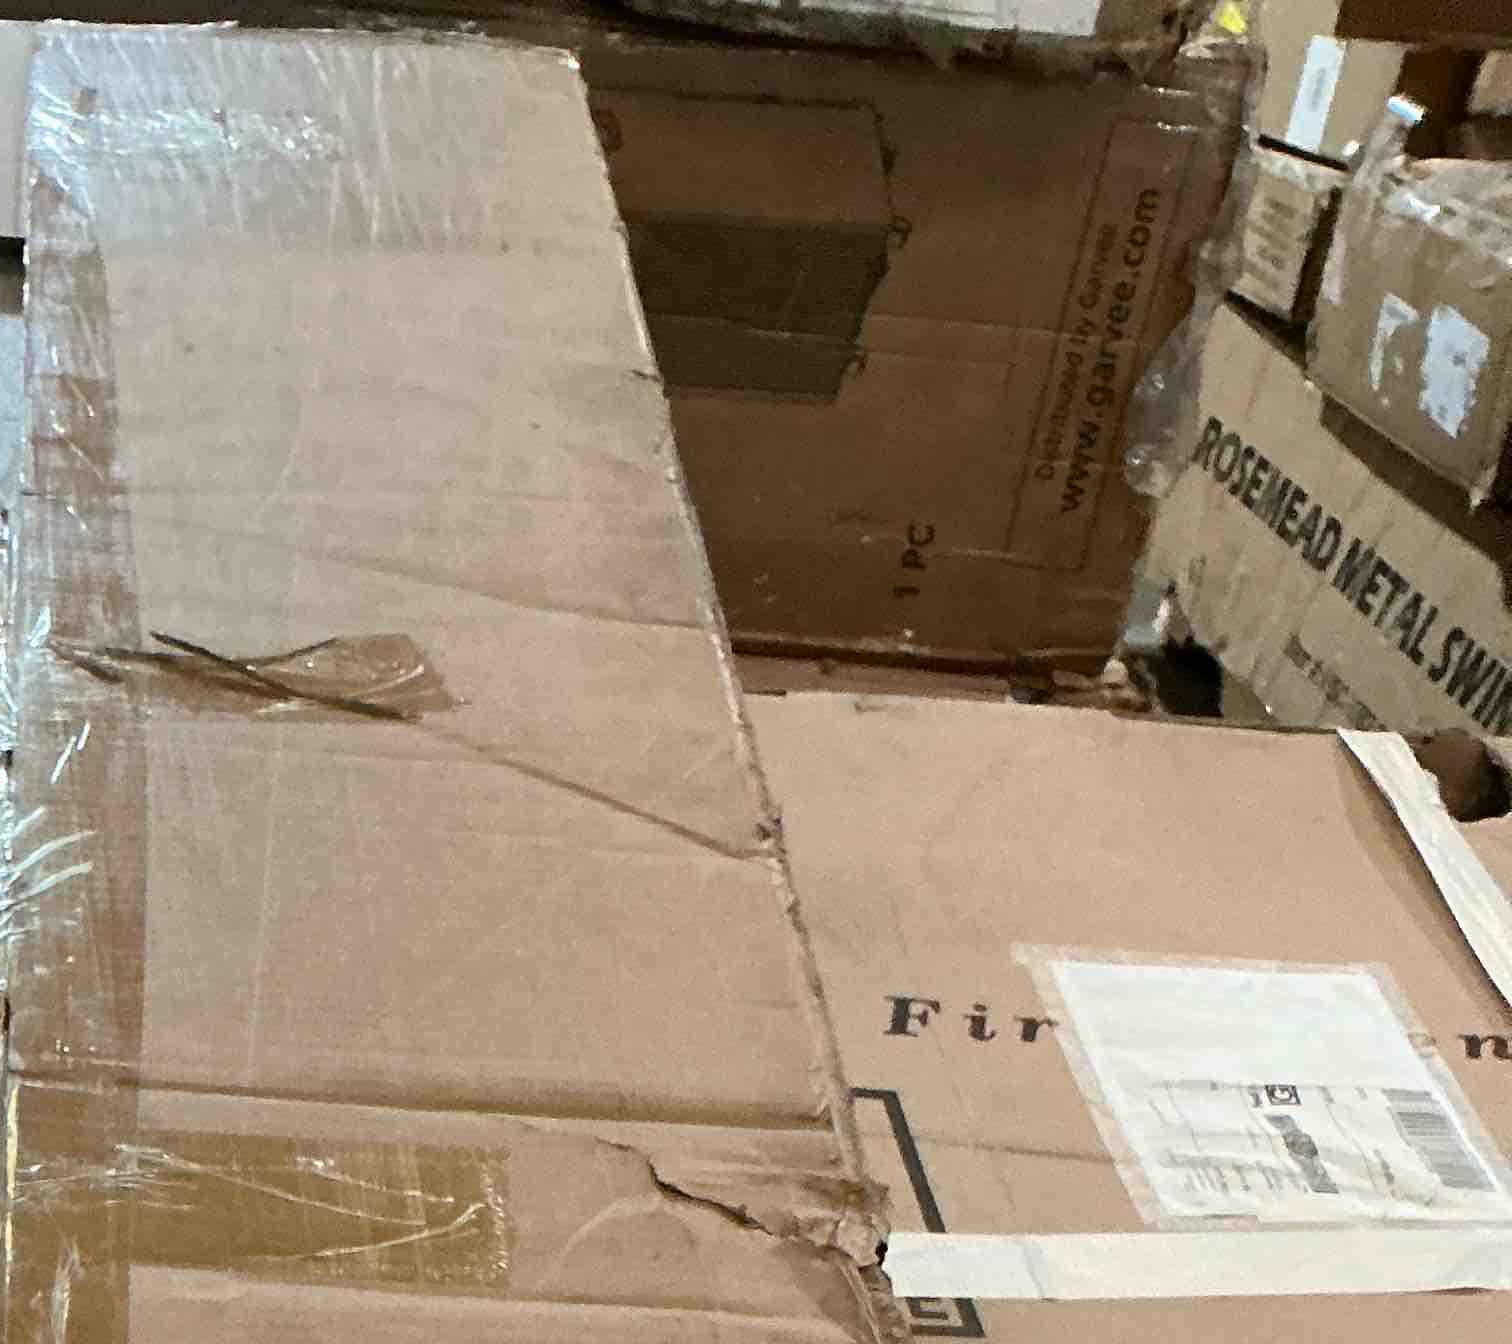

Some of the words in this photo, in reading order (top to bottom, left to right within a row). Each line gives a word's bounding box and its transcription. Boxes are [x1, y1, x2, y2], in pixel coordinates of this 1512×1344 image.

[1061, 187, 1161, 513] www.garvee.com
[902, 523, 936, 570] PC
[1190, 416, 1343, 569] ROSEMEAD
[1332, 537, 1438, 666] METAL
[883, 995, 1060, 1043] Fir
